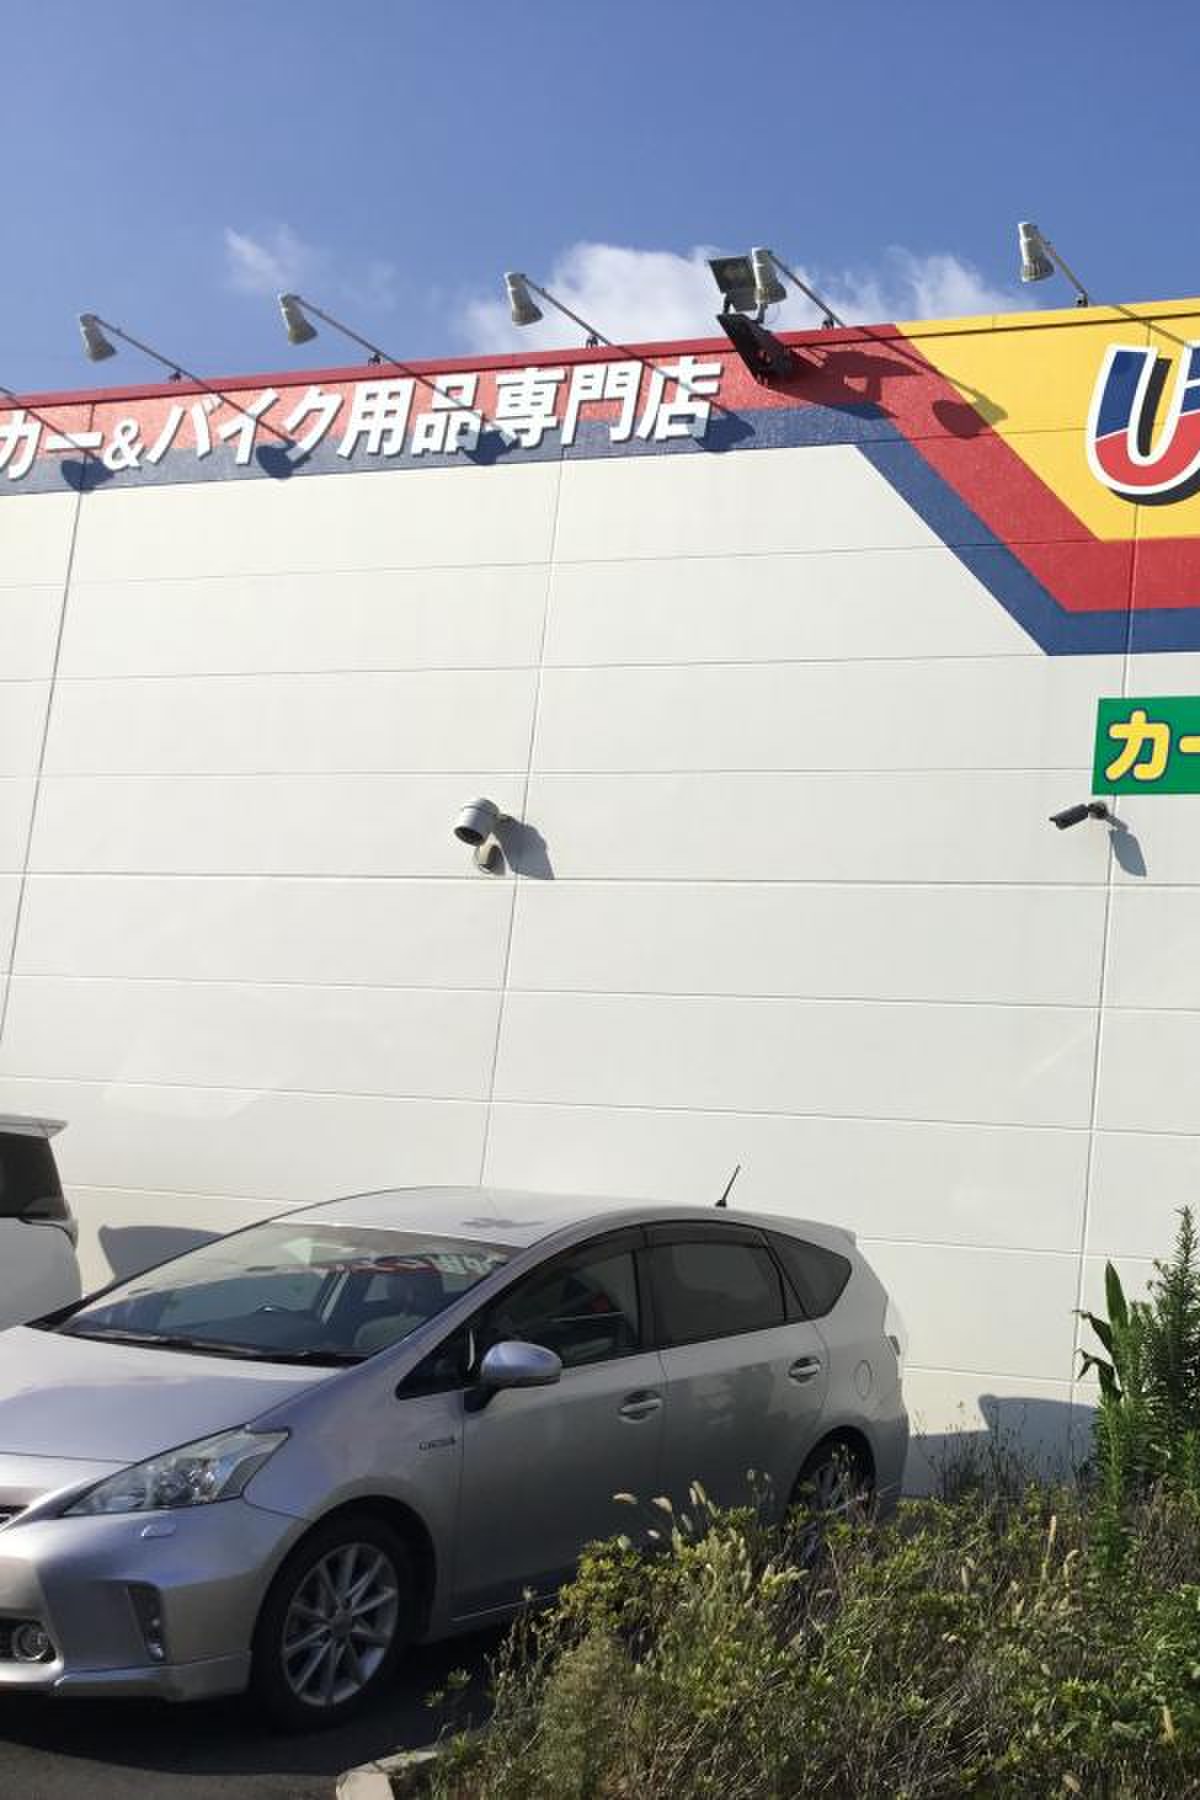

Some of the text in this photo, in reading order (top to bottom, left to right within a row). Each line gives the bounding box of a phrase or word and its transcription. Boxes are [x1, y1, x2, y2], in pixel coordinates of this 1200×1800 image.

[0, 355, 722, 481] カー&バイク用品専門店
